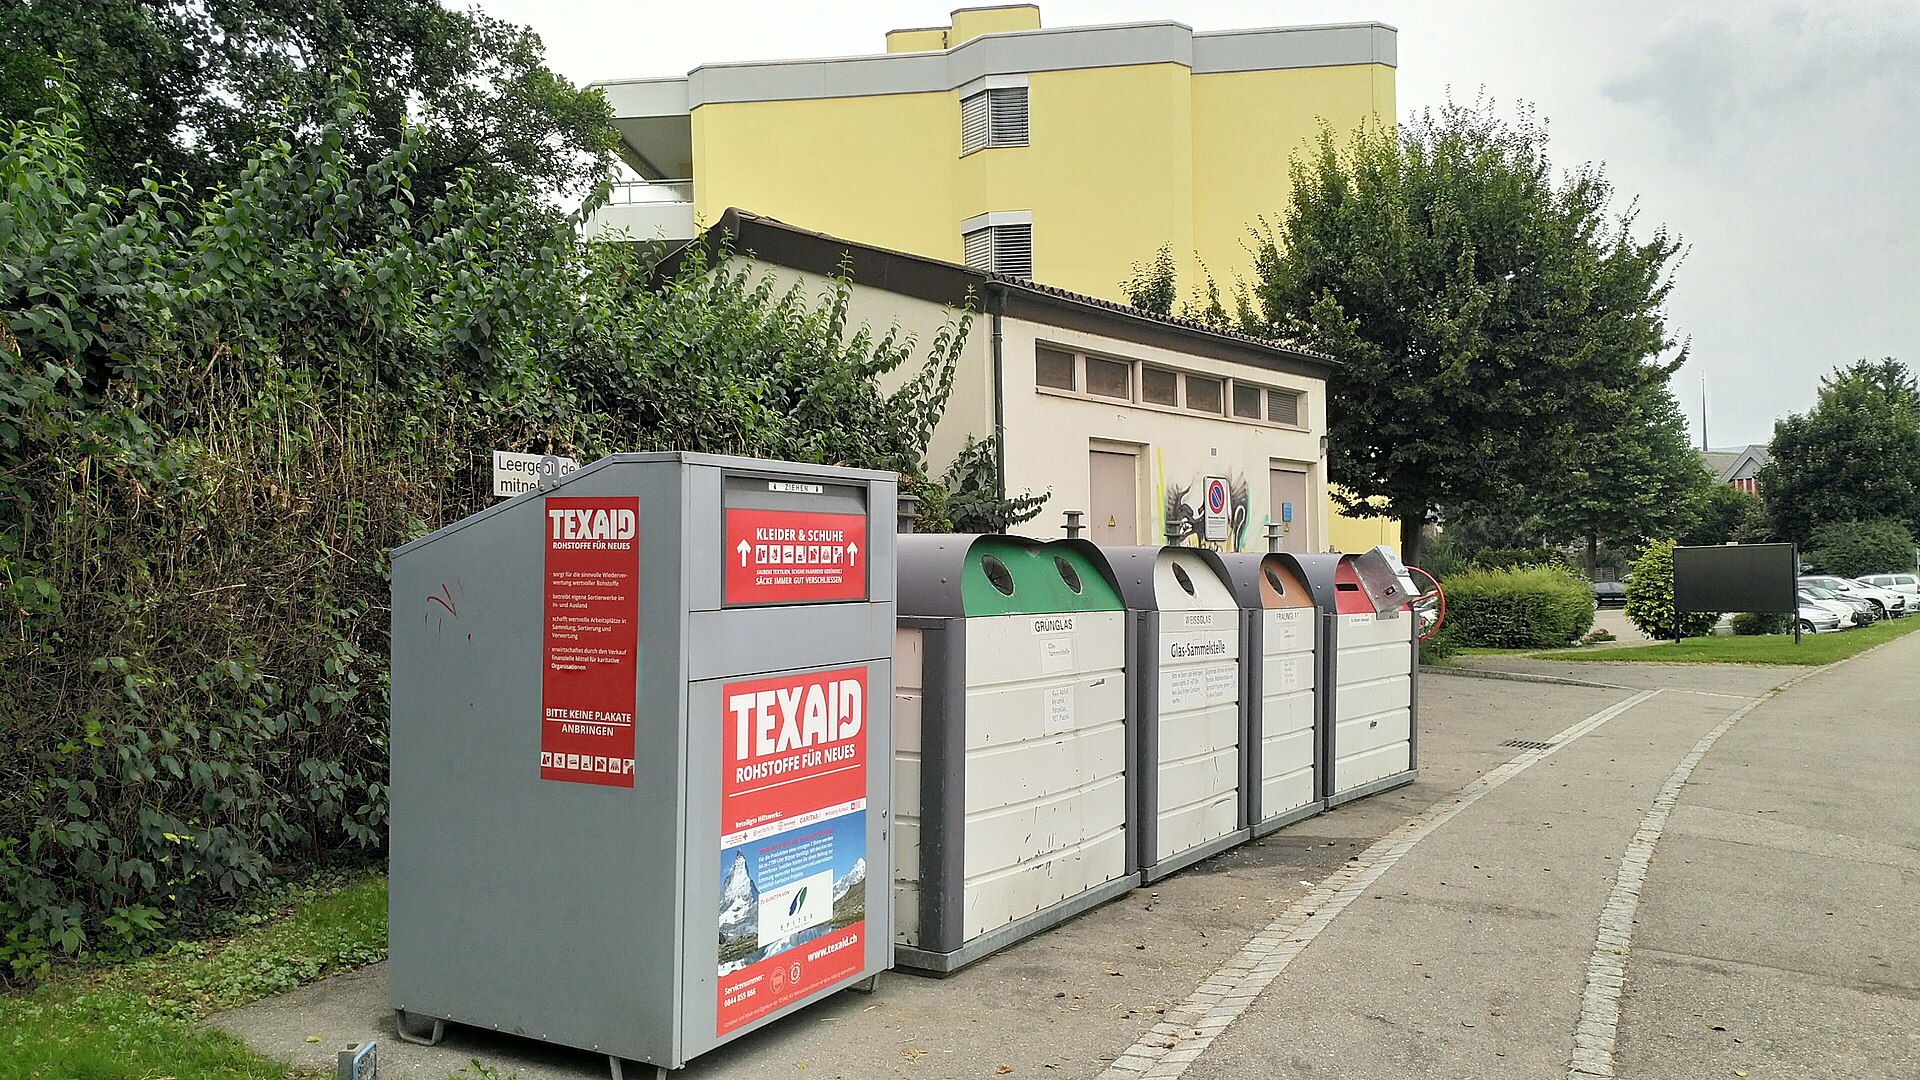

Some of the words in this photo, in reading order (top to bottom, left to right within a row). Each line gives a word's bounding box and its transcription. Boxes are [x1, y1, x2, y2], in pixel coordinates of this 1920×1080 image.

[501, 478, 540, 492] mitne
[785, 483, 809, 492] ZIEHEN
[549, 509, 636, 540] TEXAID
[756, 528, 796, 541] KLEIDER
[798, 529, 805, 541] &
[808, 529, 843, 542] SCHUHE
[553, 542, 591, 550] ROHSTOFFE
[592, 541, 606, 550] FÜR
[607, 542, 630, 550] NEUES
[756, 576, 773, 585] SÄCKE
[805, 576, 842, 584] VERSCHLIESSEN
[1035, 619, 1073, 632] GRÜNGLAS
[1185, 615, 1211, 624] WEISSGLAS
[1170, 640, 1226, 658] Glas-Sammelstelle
[546, 708, 568, 718] BITTE
[569, 709, 594, 720] KEINE
[595, 711, 631, 723] PLAKATE
[729, 679, 862, 761] TEXAID
[561, 724, 614, 737] ANBRINGEN
[736, 760, 800, 784] ROHSTOFFE
[802, 749, 822, 769] FÜR
[824, 744, 855, 764] NEUES
[800, 813, 819, 823] CARITAS
[807, 933, 858, 962] www.texaid.ch
[724, 974, 765, 995] Servicenummer:
[724, 996, 737, 1008] 0844
